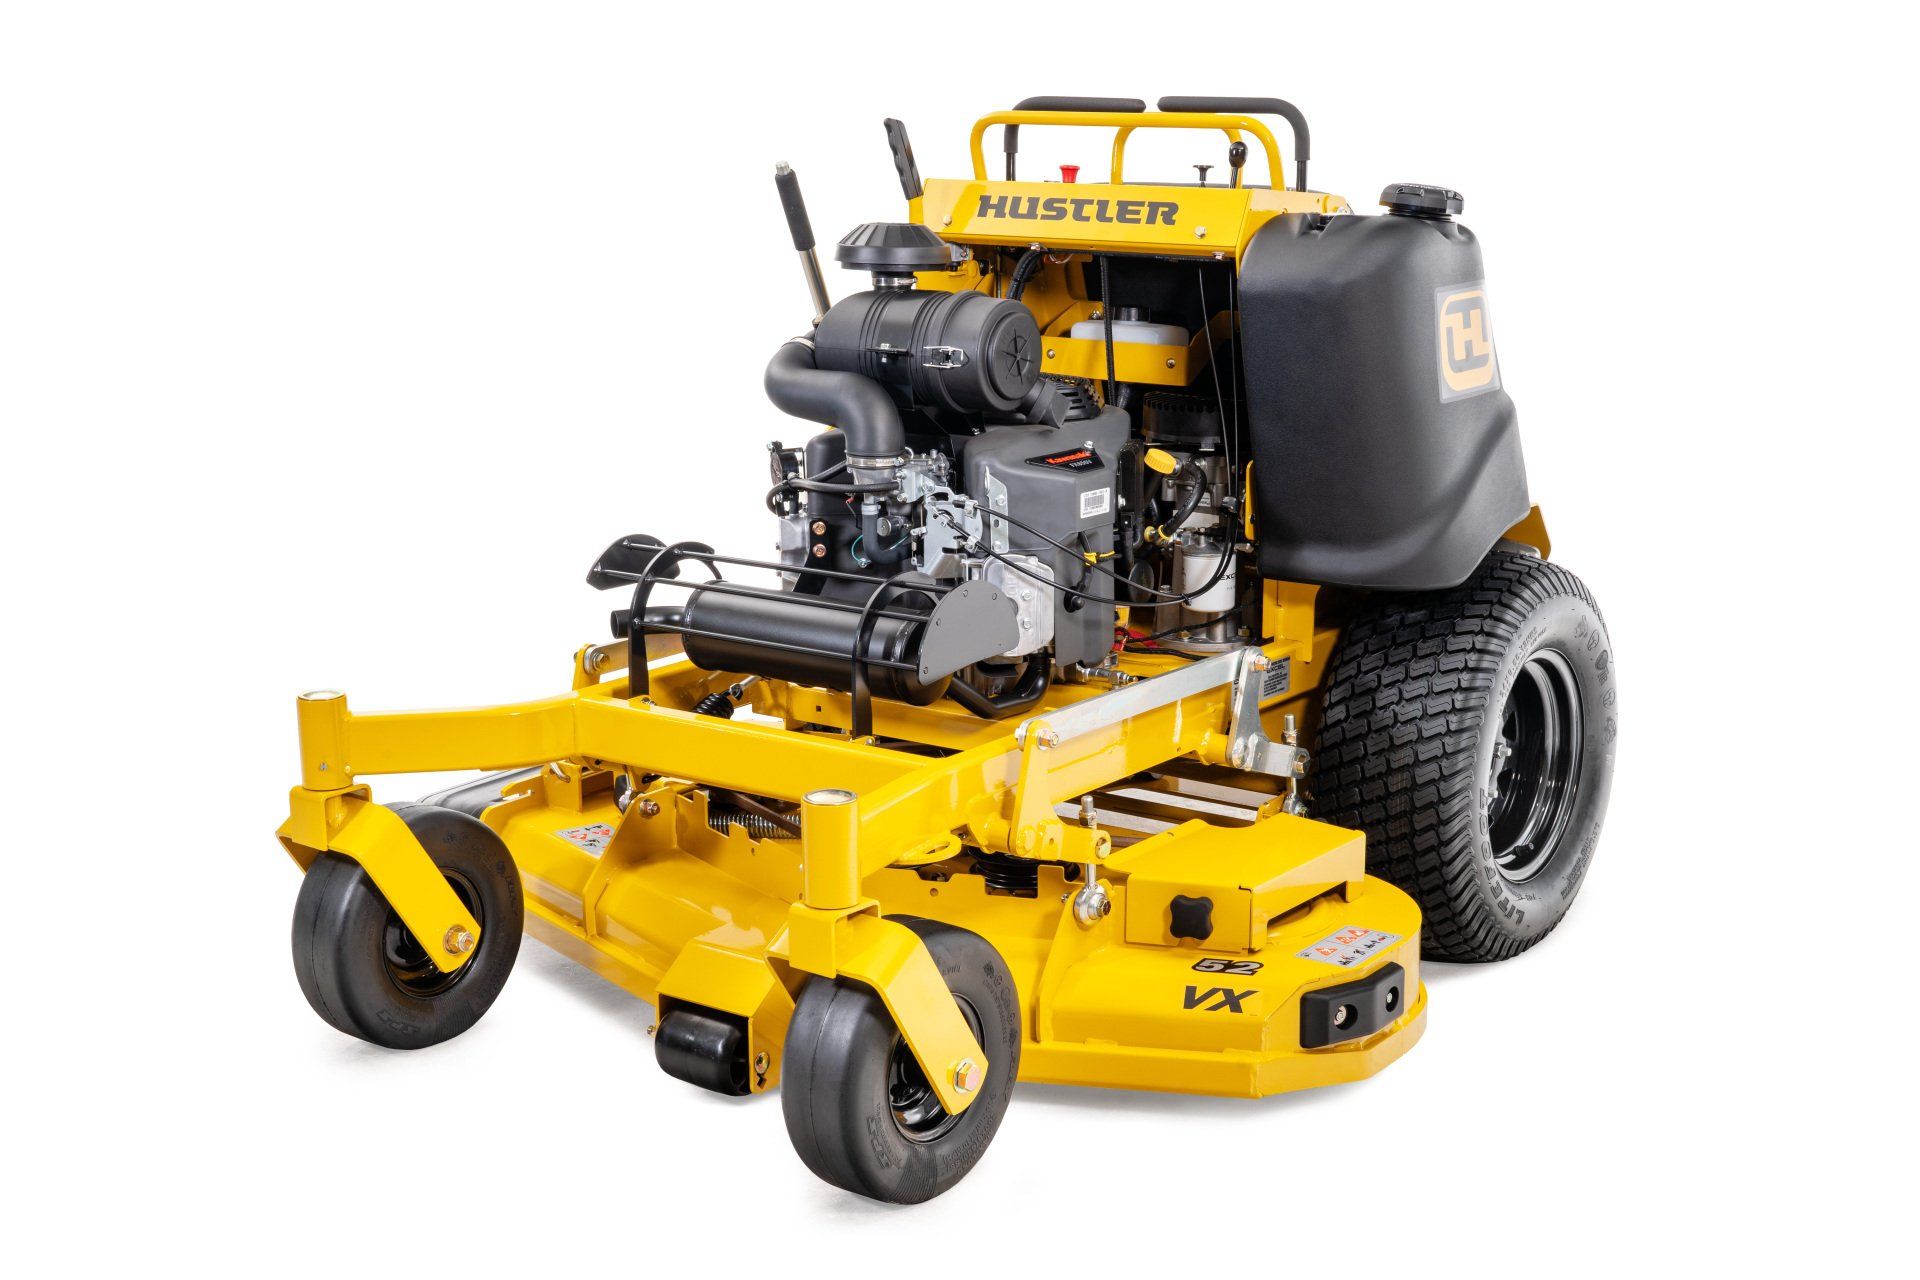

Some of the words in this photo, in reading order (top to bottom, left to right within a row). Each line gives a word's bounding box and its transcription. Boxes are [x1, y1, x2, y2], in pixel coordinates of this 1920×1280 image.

[977, 194, 1180, 226] HUSTLER
[1478, 787, 1526, 926] LITEFOOT
[1191, 957, 1265, 977] 52
[1182, 985, 1260, 1014] VX
